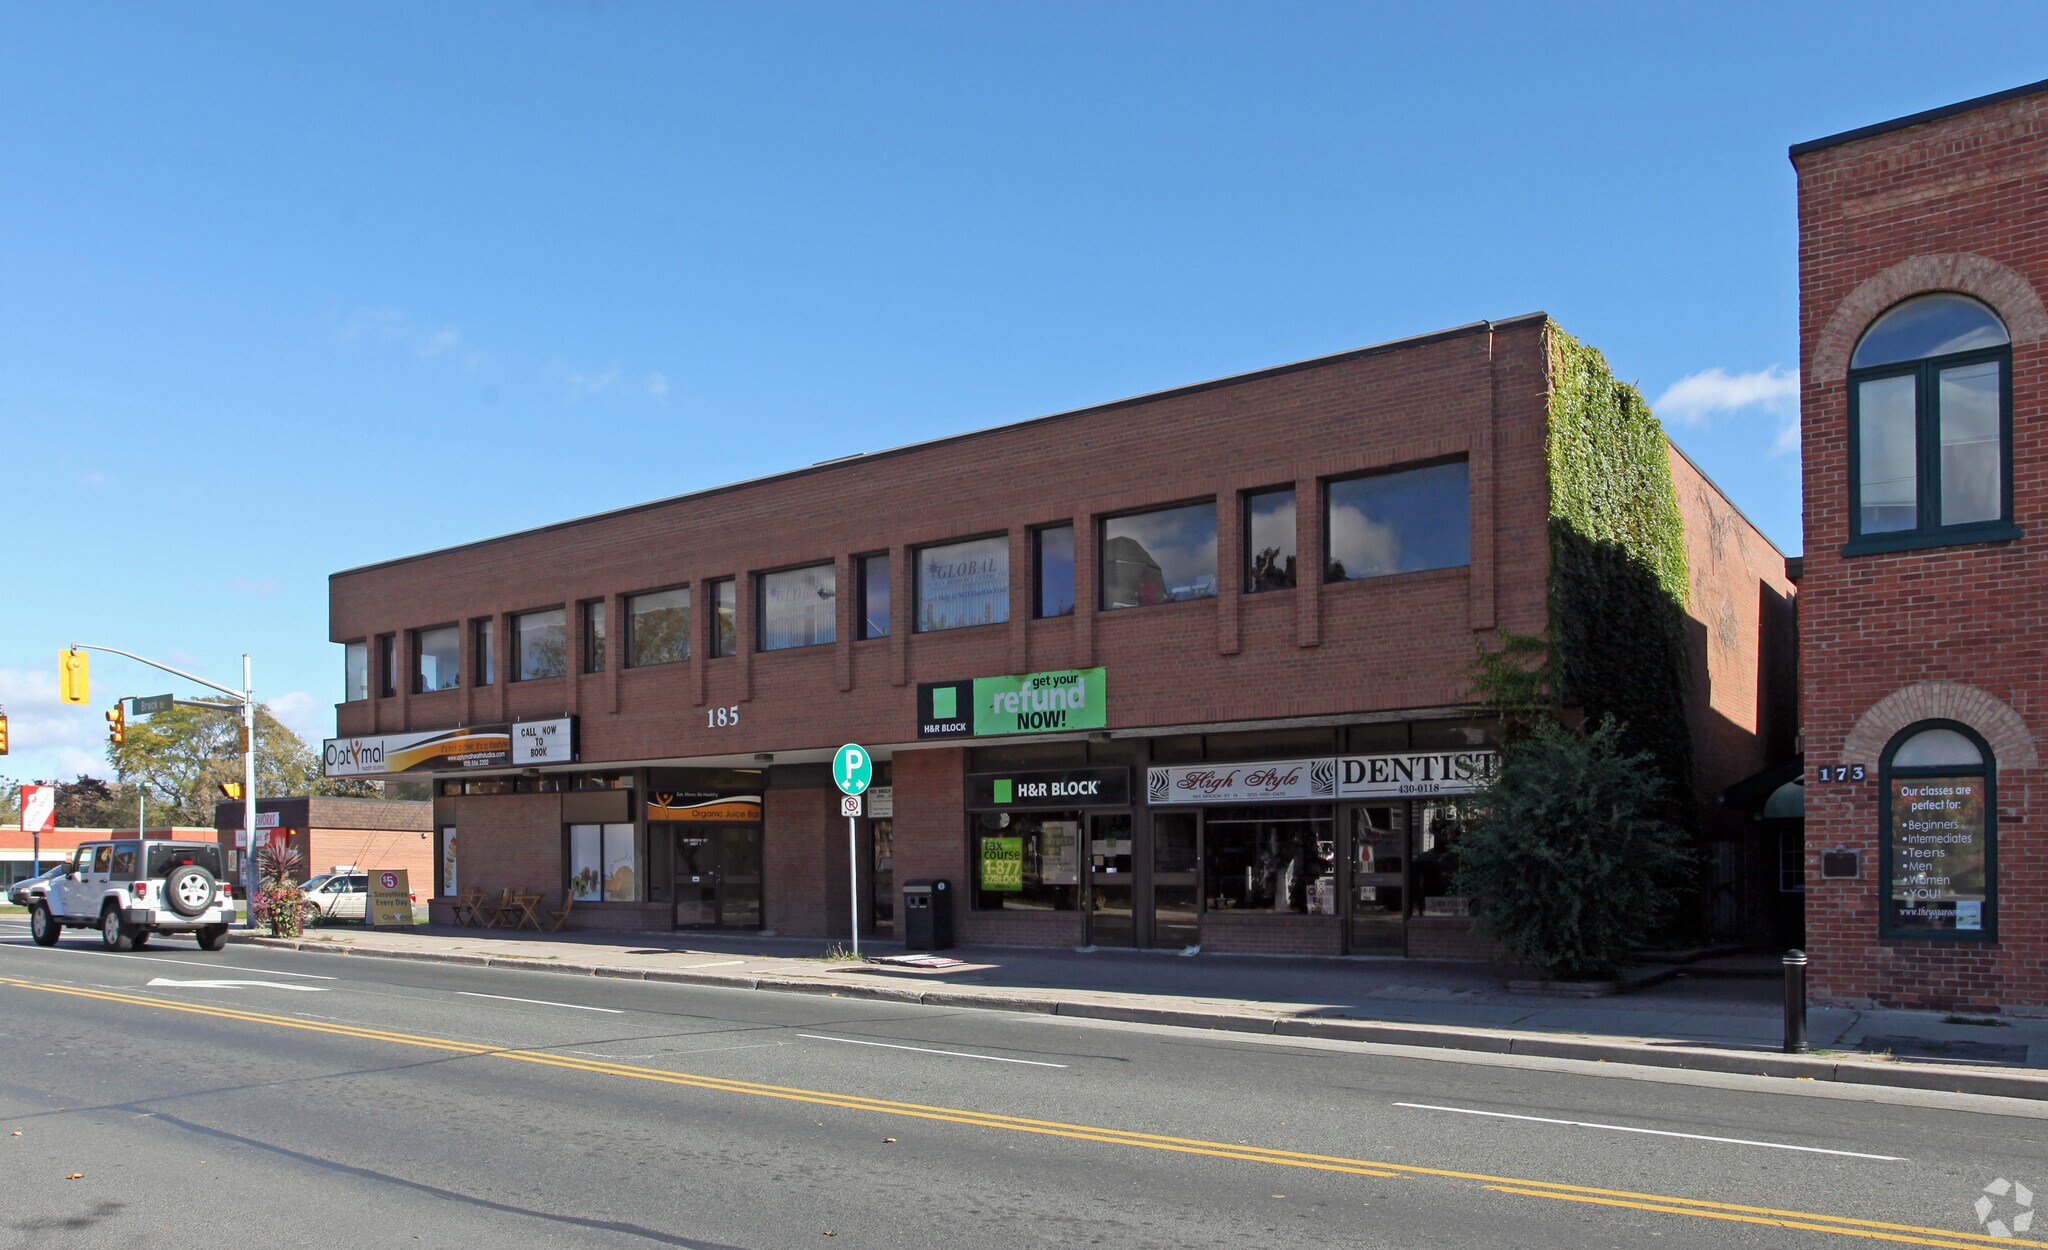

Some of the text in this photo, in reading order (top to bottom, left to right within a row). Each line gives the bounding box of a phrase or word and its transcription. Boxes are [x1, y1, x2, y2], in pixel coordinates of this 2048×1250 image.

[937, 558, 997, 580] GLOBAL
[1033, 674, 1078, 689] get your
[994, 678, 1086, 714] refund
[708, 705, 739, 728] 185
[1018, 710, 1066, 730] NOW!
[521, 726, 557, 737] CALL NOW
[924, 722, 966, 733] H&R BLOCK
[535, 738, 543, 746] TO
[530, 748, 547, 757] BOOK
[846, 750, 863, 779] P
[1342, 753, 1498, 784] DENTIST
[1820, 767, 1864, 781] 173
[1176, 767, 1303, 794] High Style
[1018, 783, 1047, 797] H&R
[1398, 784, 1440, 794] 430-0118
[1901, 786, 1971, 796] Our classes are
[1911, 800, 1961, 812] perfect for:
[692, 809, 722, 818] Organic
[725, 810, 745, 818] Juice
[1908, 820, 1959, 832] Beginners
[1908, 833, 1972, 843] Intermediates
[984, 840, 1003, 850] tax
[984, 850, 1020, 860] course
[1909, 848, 1945, 857] Teens
[984, 860, 1020, 874] 1-877
[1909, 862, 1932, 871] Men
[383, 876, 394, 887] $5
[984, 874, 1020, 884] 32BLOCK
[1910, 876, 1950, 885] Women
[1910, 889, 1941, 899] YOU!
[376, 899, 393, 907] Every
